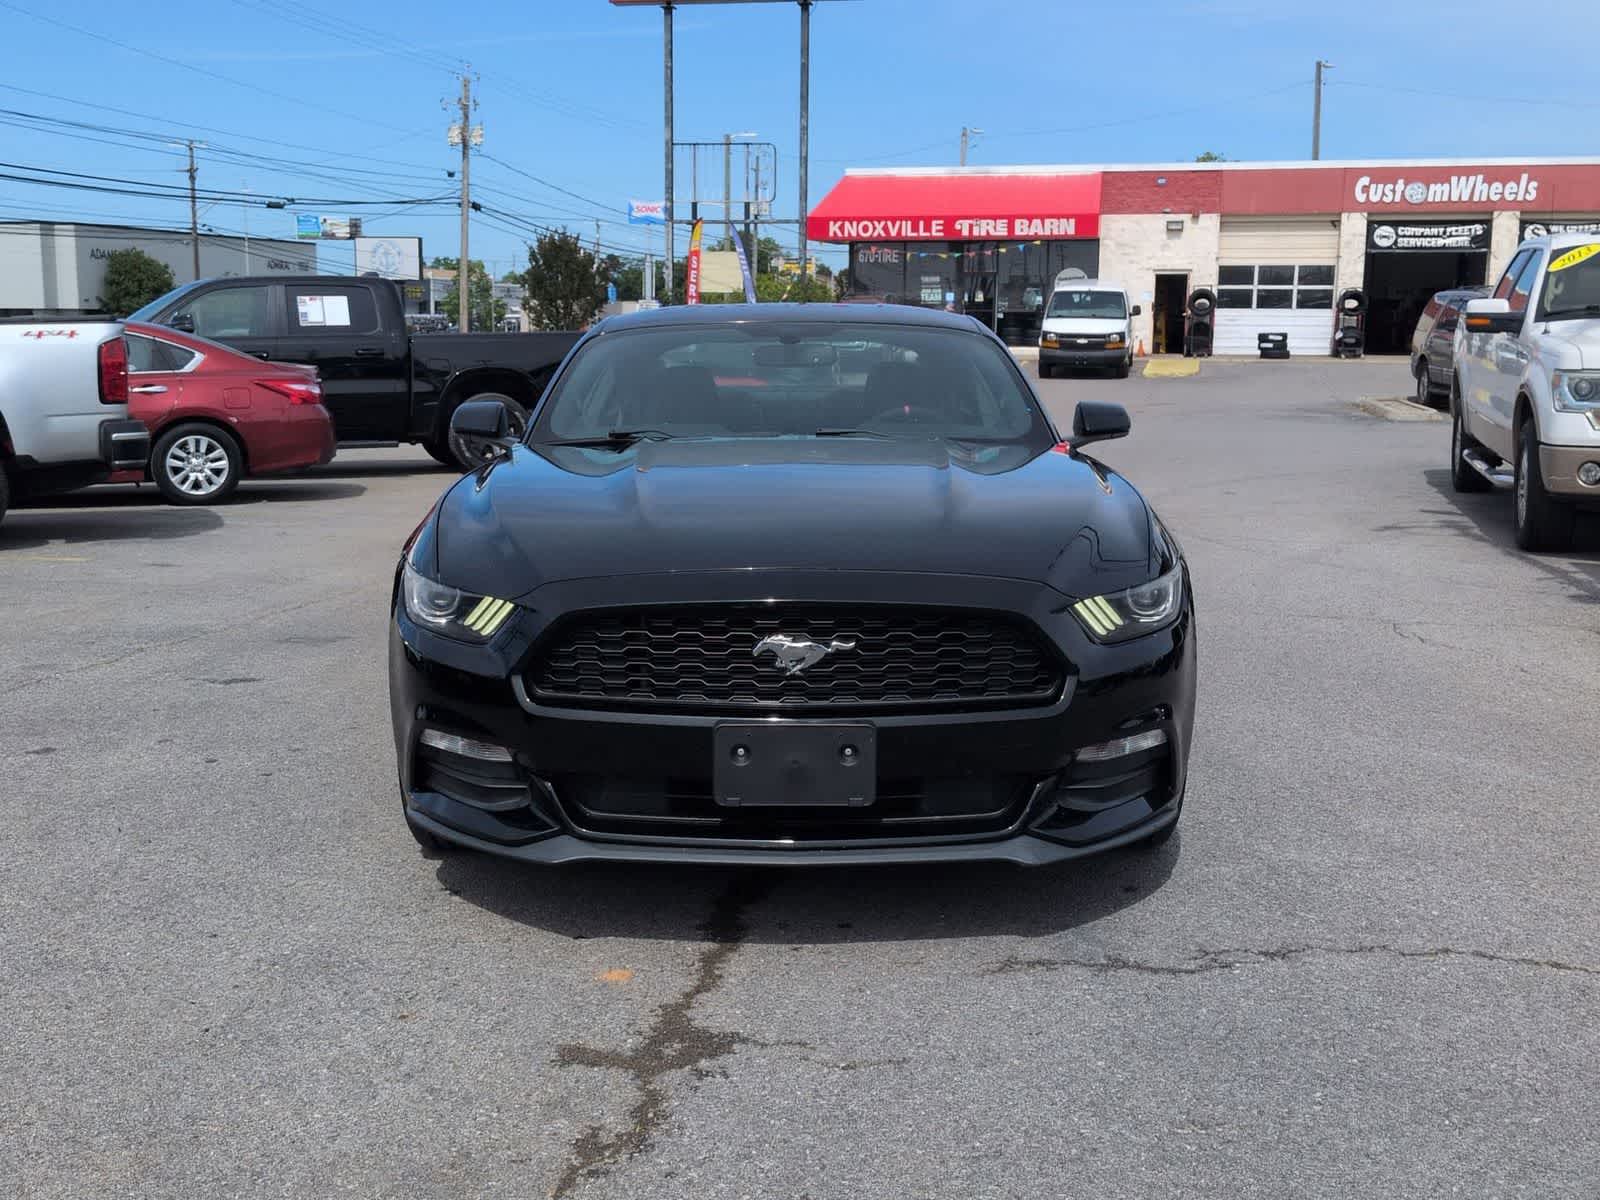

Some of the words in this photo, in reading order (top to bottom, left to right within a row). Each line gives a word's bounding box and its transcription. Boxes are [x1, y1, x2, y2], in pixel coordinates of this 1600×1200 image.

[828, 220, 944, 238] KNOXVILLE
[1014, 217, 1076, 236] BARN
[1397, 226, 1444, 237] COMPANY
[1446, 224, 1484, 236] FLEETS
